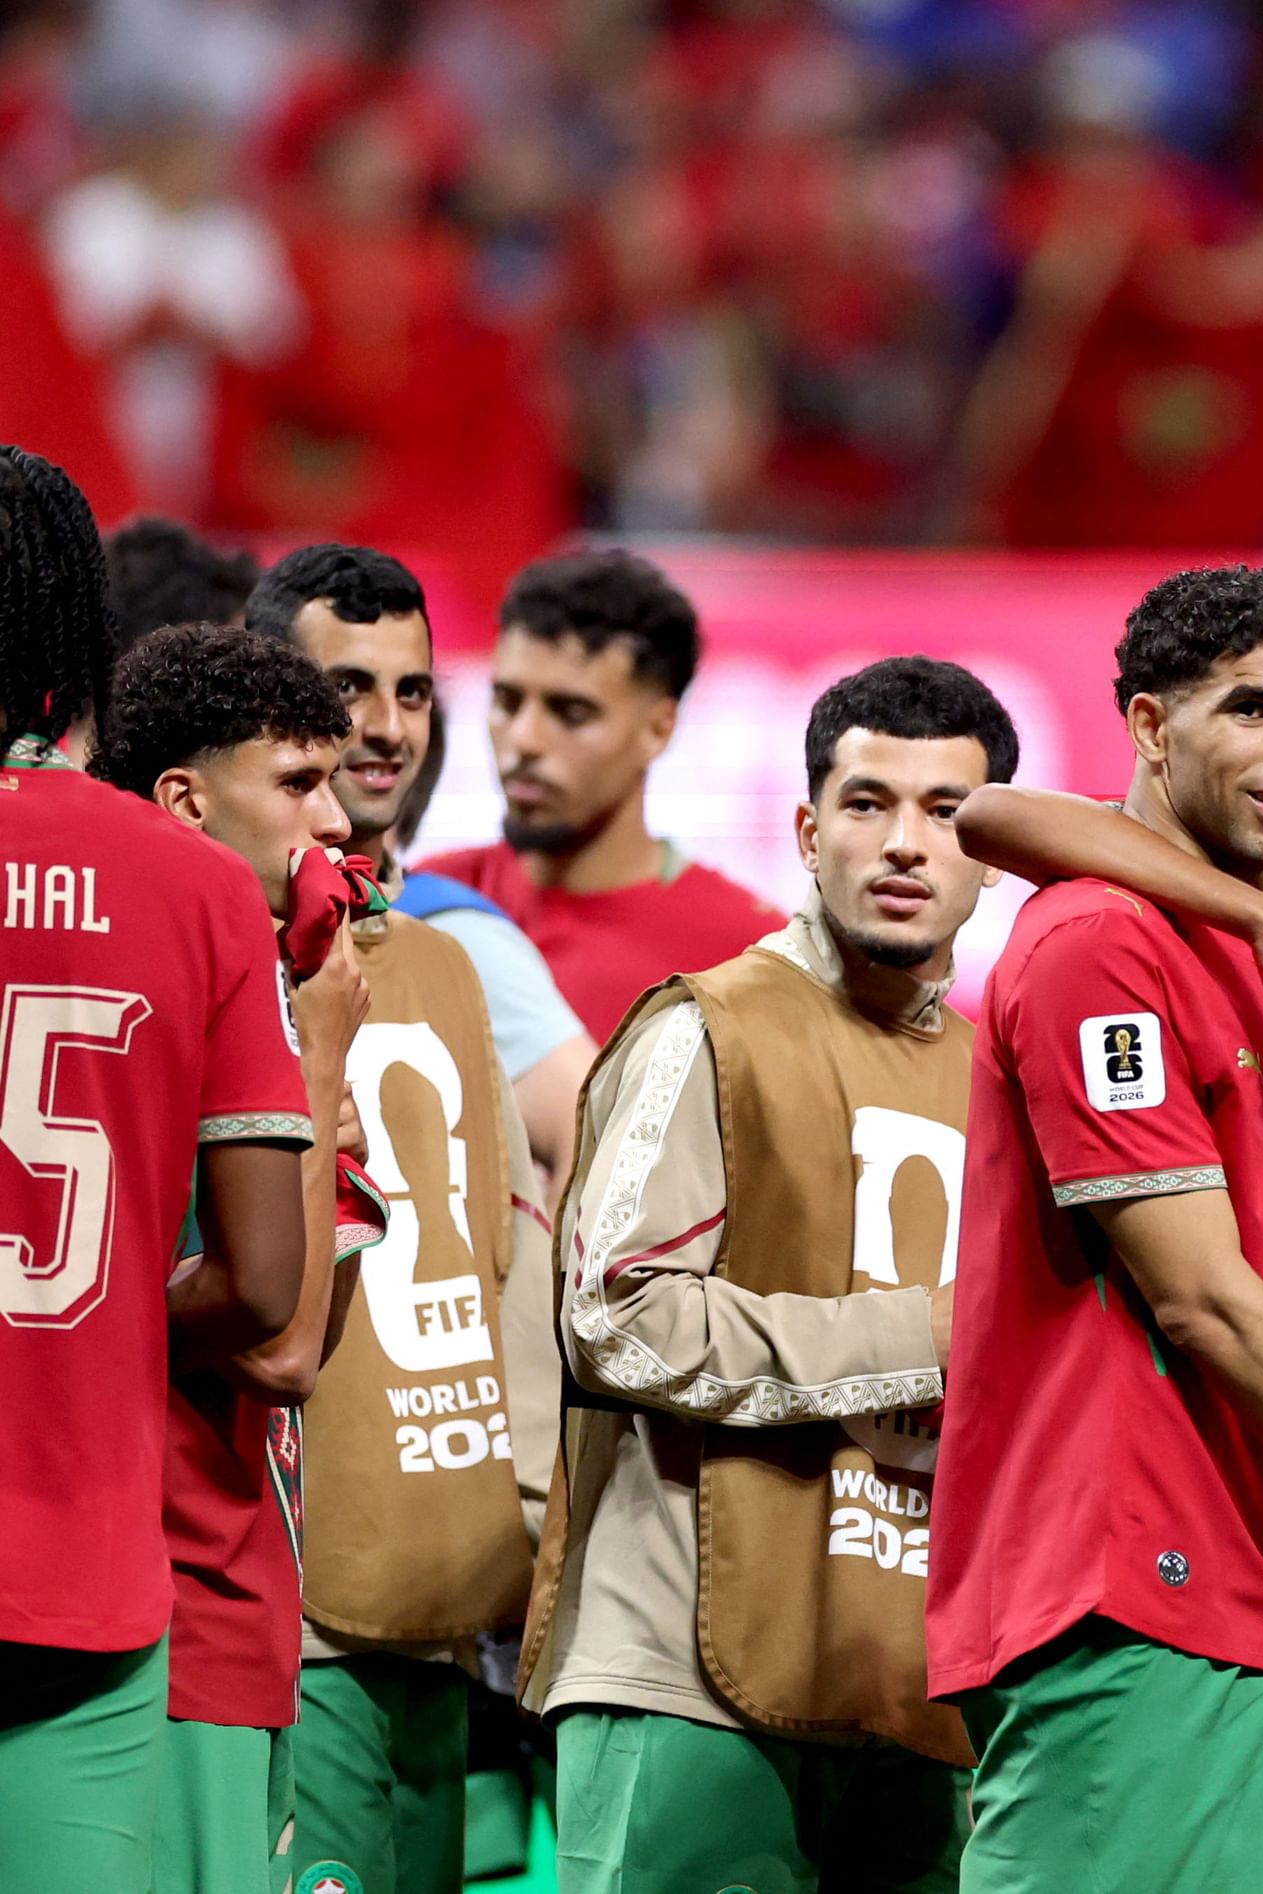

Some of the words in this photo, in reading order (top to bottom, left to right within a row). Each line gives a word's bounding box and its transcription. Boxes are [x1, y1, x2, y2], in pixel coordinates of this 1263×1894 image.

[4, 862, 110, 934] HAL
[1109, 1091, 1144, 1102] 2026
[414, 1295, 485, 1337] FIF
[386, 1376, 501, 1418] WORLD
[831, 1469, 929, 1519] WORLD
